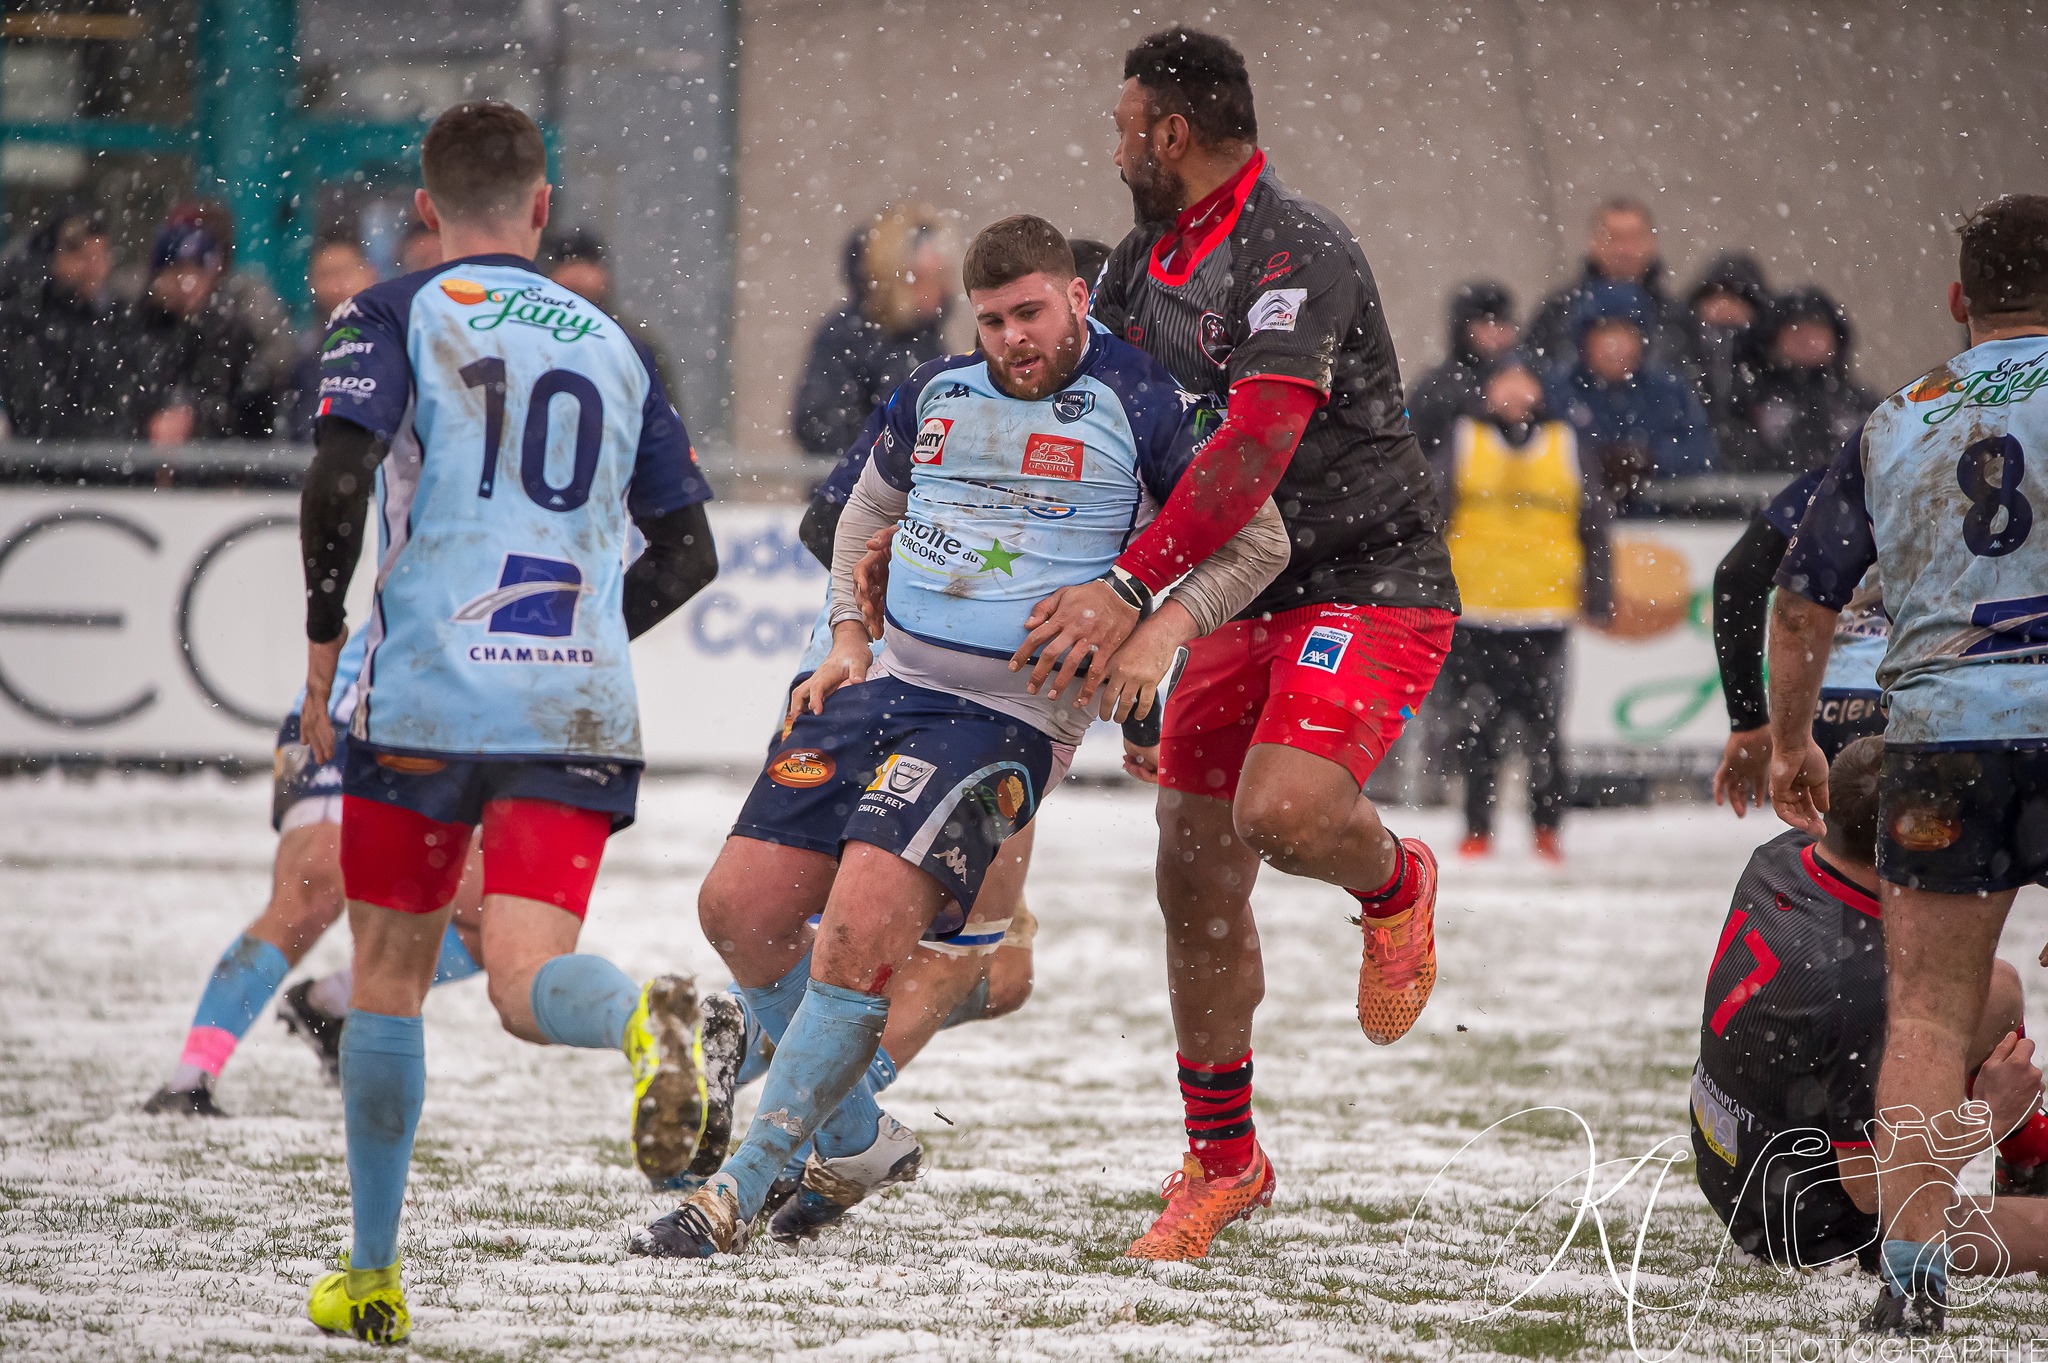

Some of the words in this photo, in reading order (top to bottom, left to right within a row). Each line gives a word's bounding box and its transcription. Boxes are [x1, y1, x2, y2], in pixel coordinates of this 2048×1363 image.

[469, 287, 602, 342] Jany
[458, 356, 604, 513] 10
[1028, 461, 1074, 474] GENERALI
[1957, 433, 2033, 557] 8
[900, 532, 946, 566] VERCORS
[962, 551, 979, 564] du
[1312, 631, 1348, 644] Bouvarel
[469, 646, 595, 664] CHAMBARD
[1302, 650, 1329, 666] AXA
[780, 762, 822, 775] AGAPES
[900, 761, 924, 773] DACIA
[858, 804, 888, 817] CHATTE
[884, 796, 906, 811] REY
